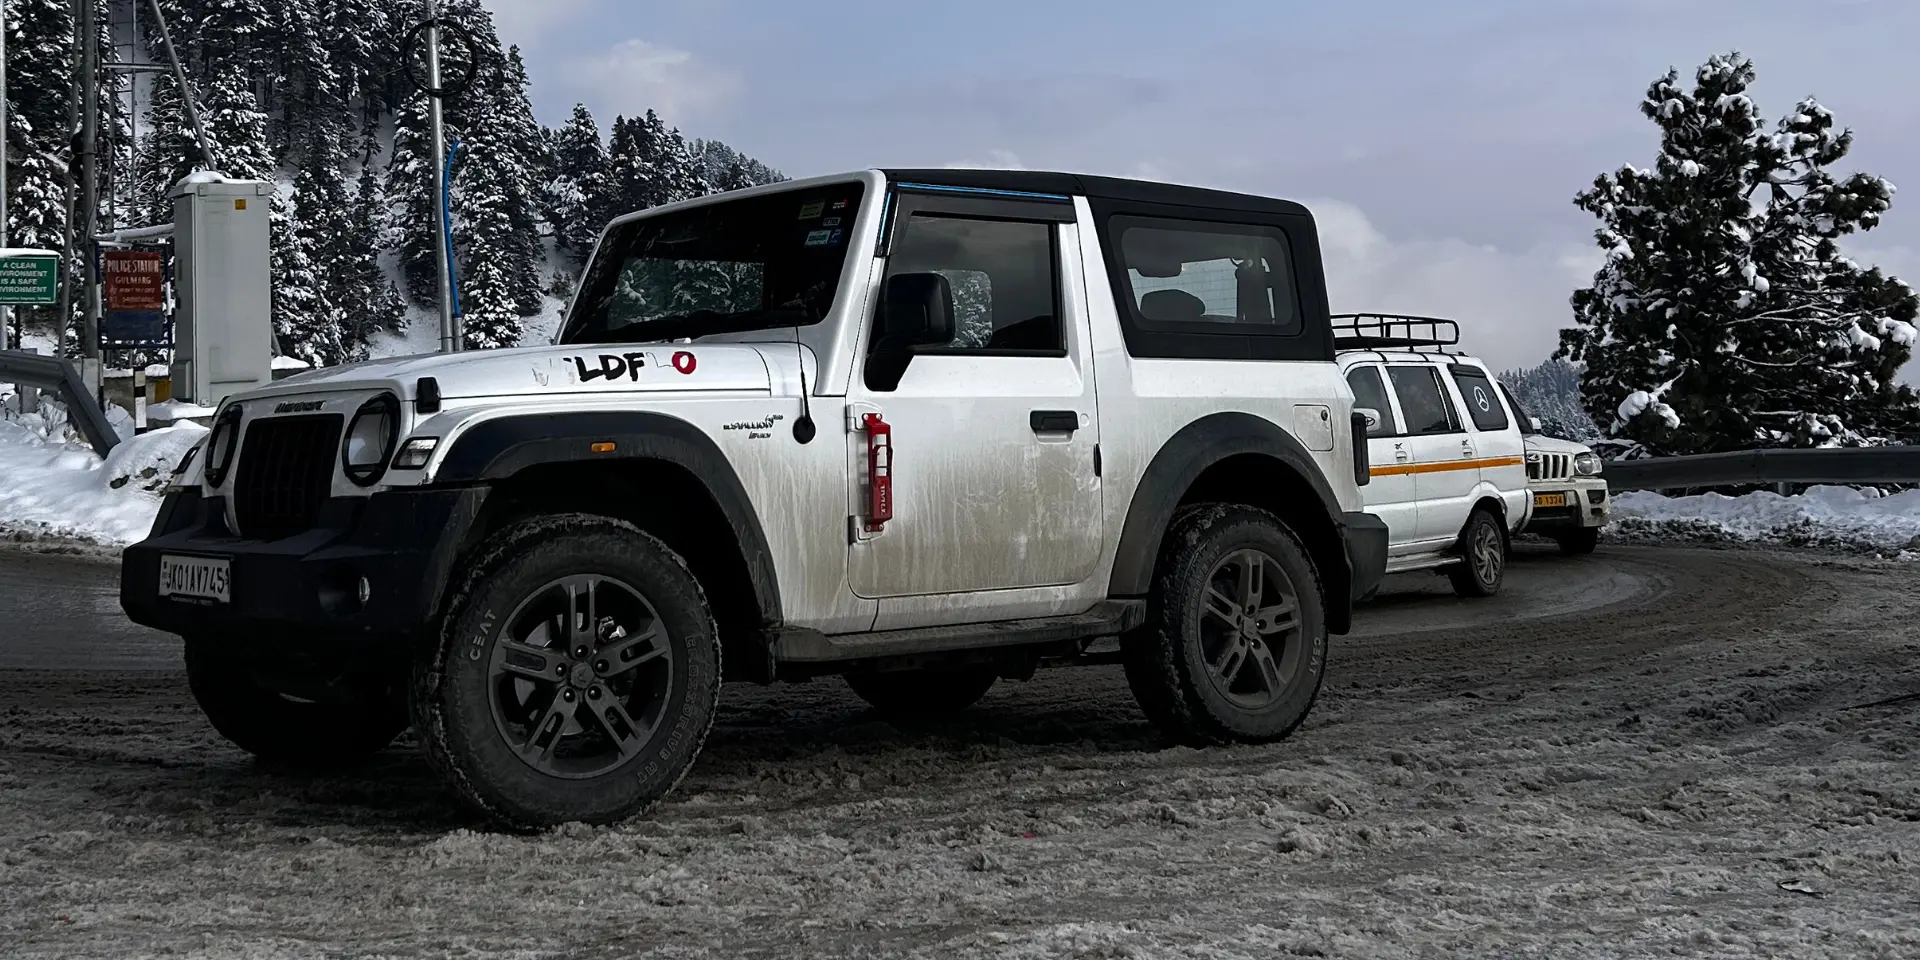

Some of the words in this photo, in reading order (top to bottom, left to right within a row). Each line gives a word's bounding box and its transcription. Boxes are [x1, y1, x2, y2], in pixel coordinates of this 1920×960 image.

[115, 276, 152, 285] GULMARG
[469, 608, 497, 661] CEAT
[1308, 636, 1322, 677] CEAT
